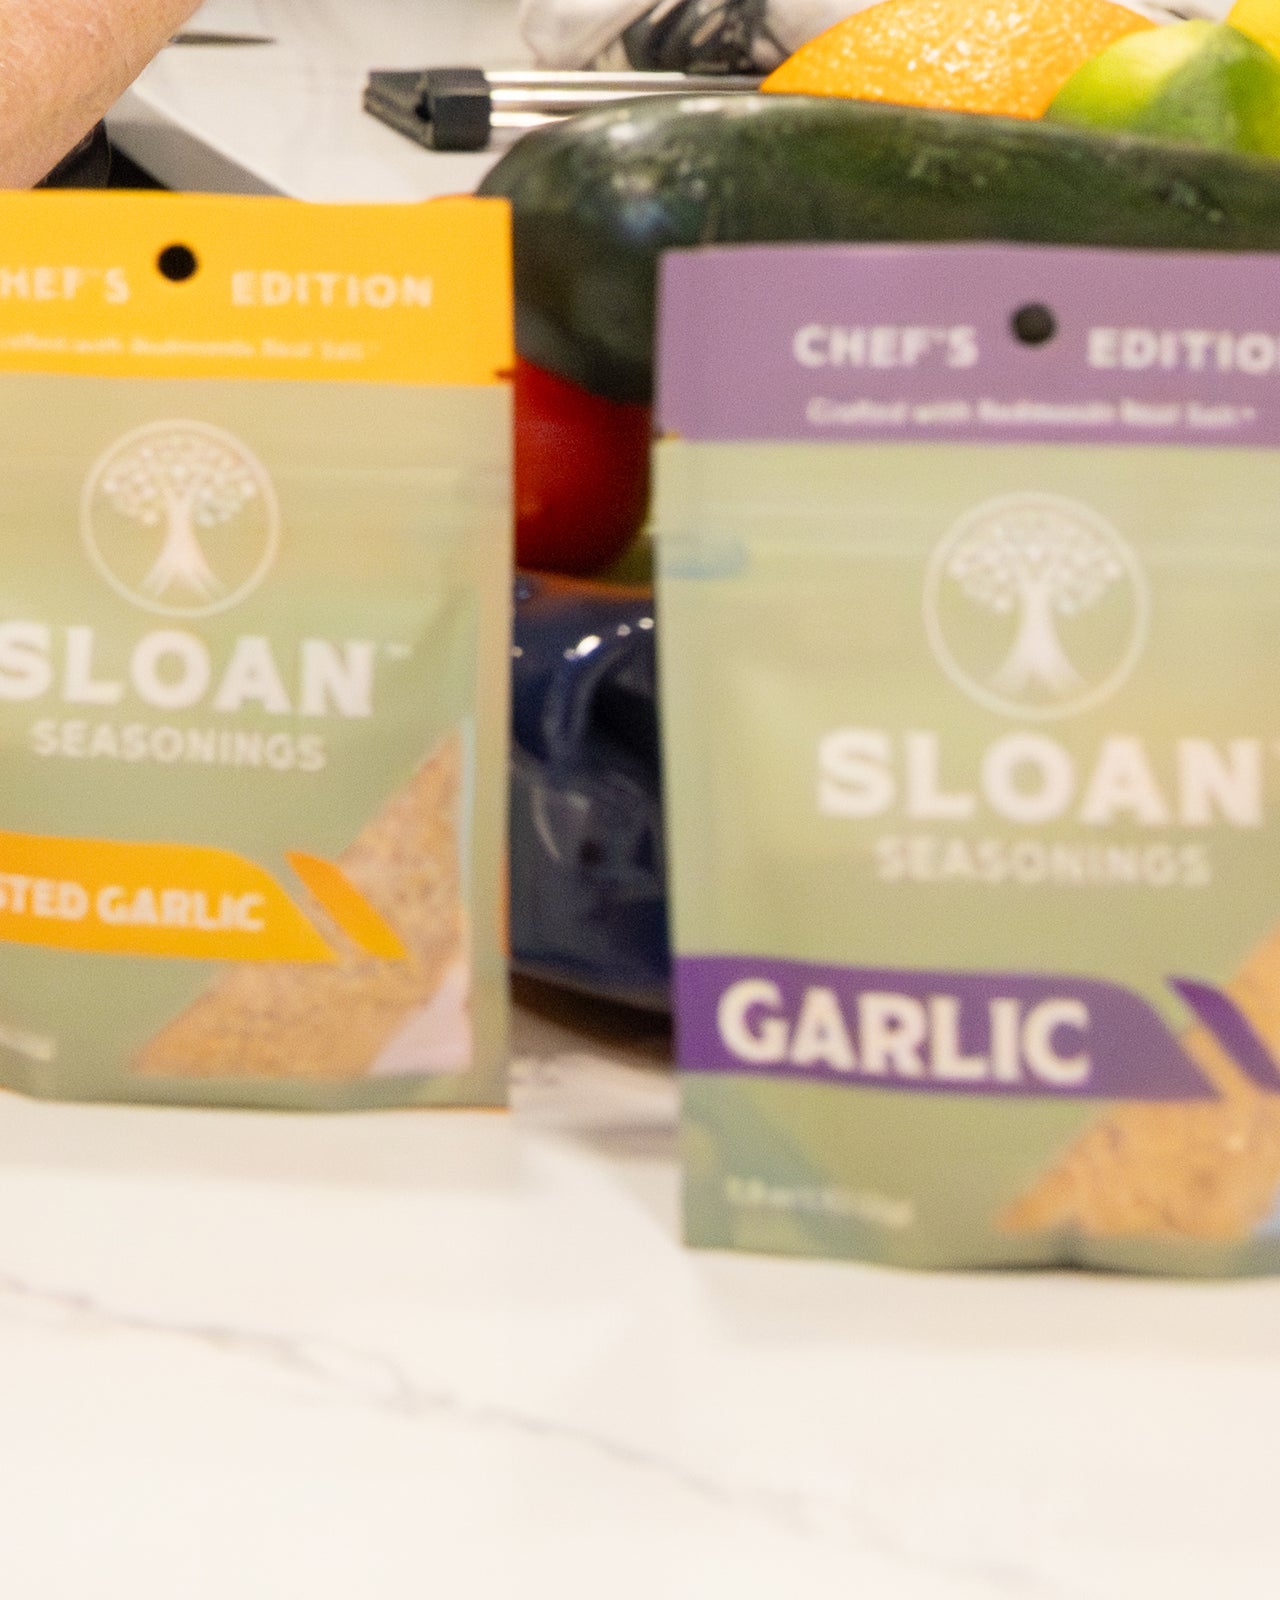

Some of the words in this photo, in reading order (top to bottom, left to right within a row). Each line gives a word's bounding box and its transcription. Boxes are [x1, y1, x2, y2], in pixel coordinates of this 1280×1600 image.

[229, 268, 435, 310] EDITION
[791, 323, 981, 370] CHEF'S
[1085, 326, 1280, 376] EDITIO
[29, 717, 328, 774] SEASONINGS
[816, 724, 1266, 830] SLOAN
[875, 833, 1212, 888] SEASONINGS
[95, 883, 267, 934] GARLIC
[715, 975, 1095, 1088] GARLIC
